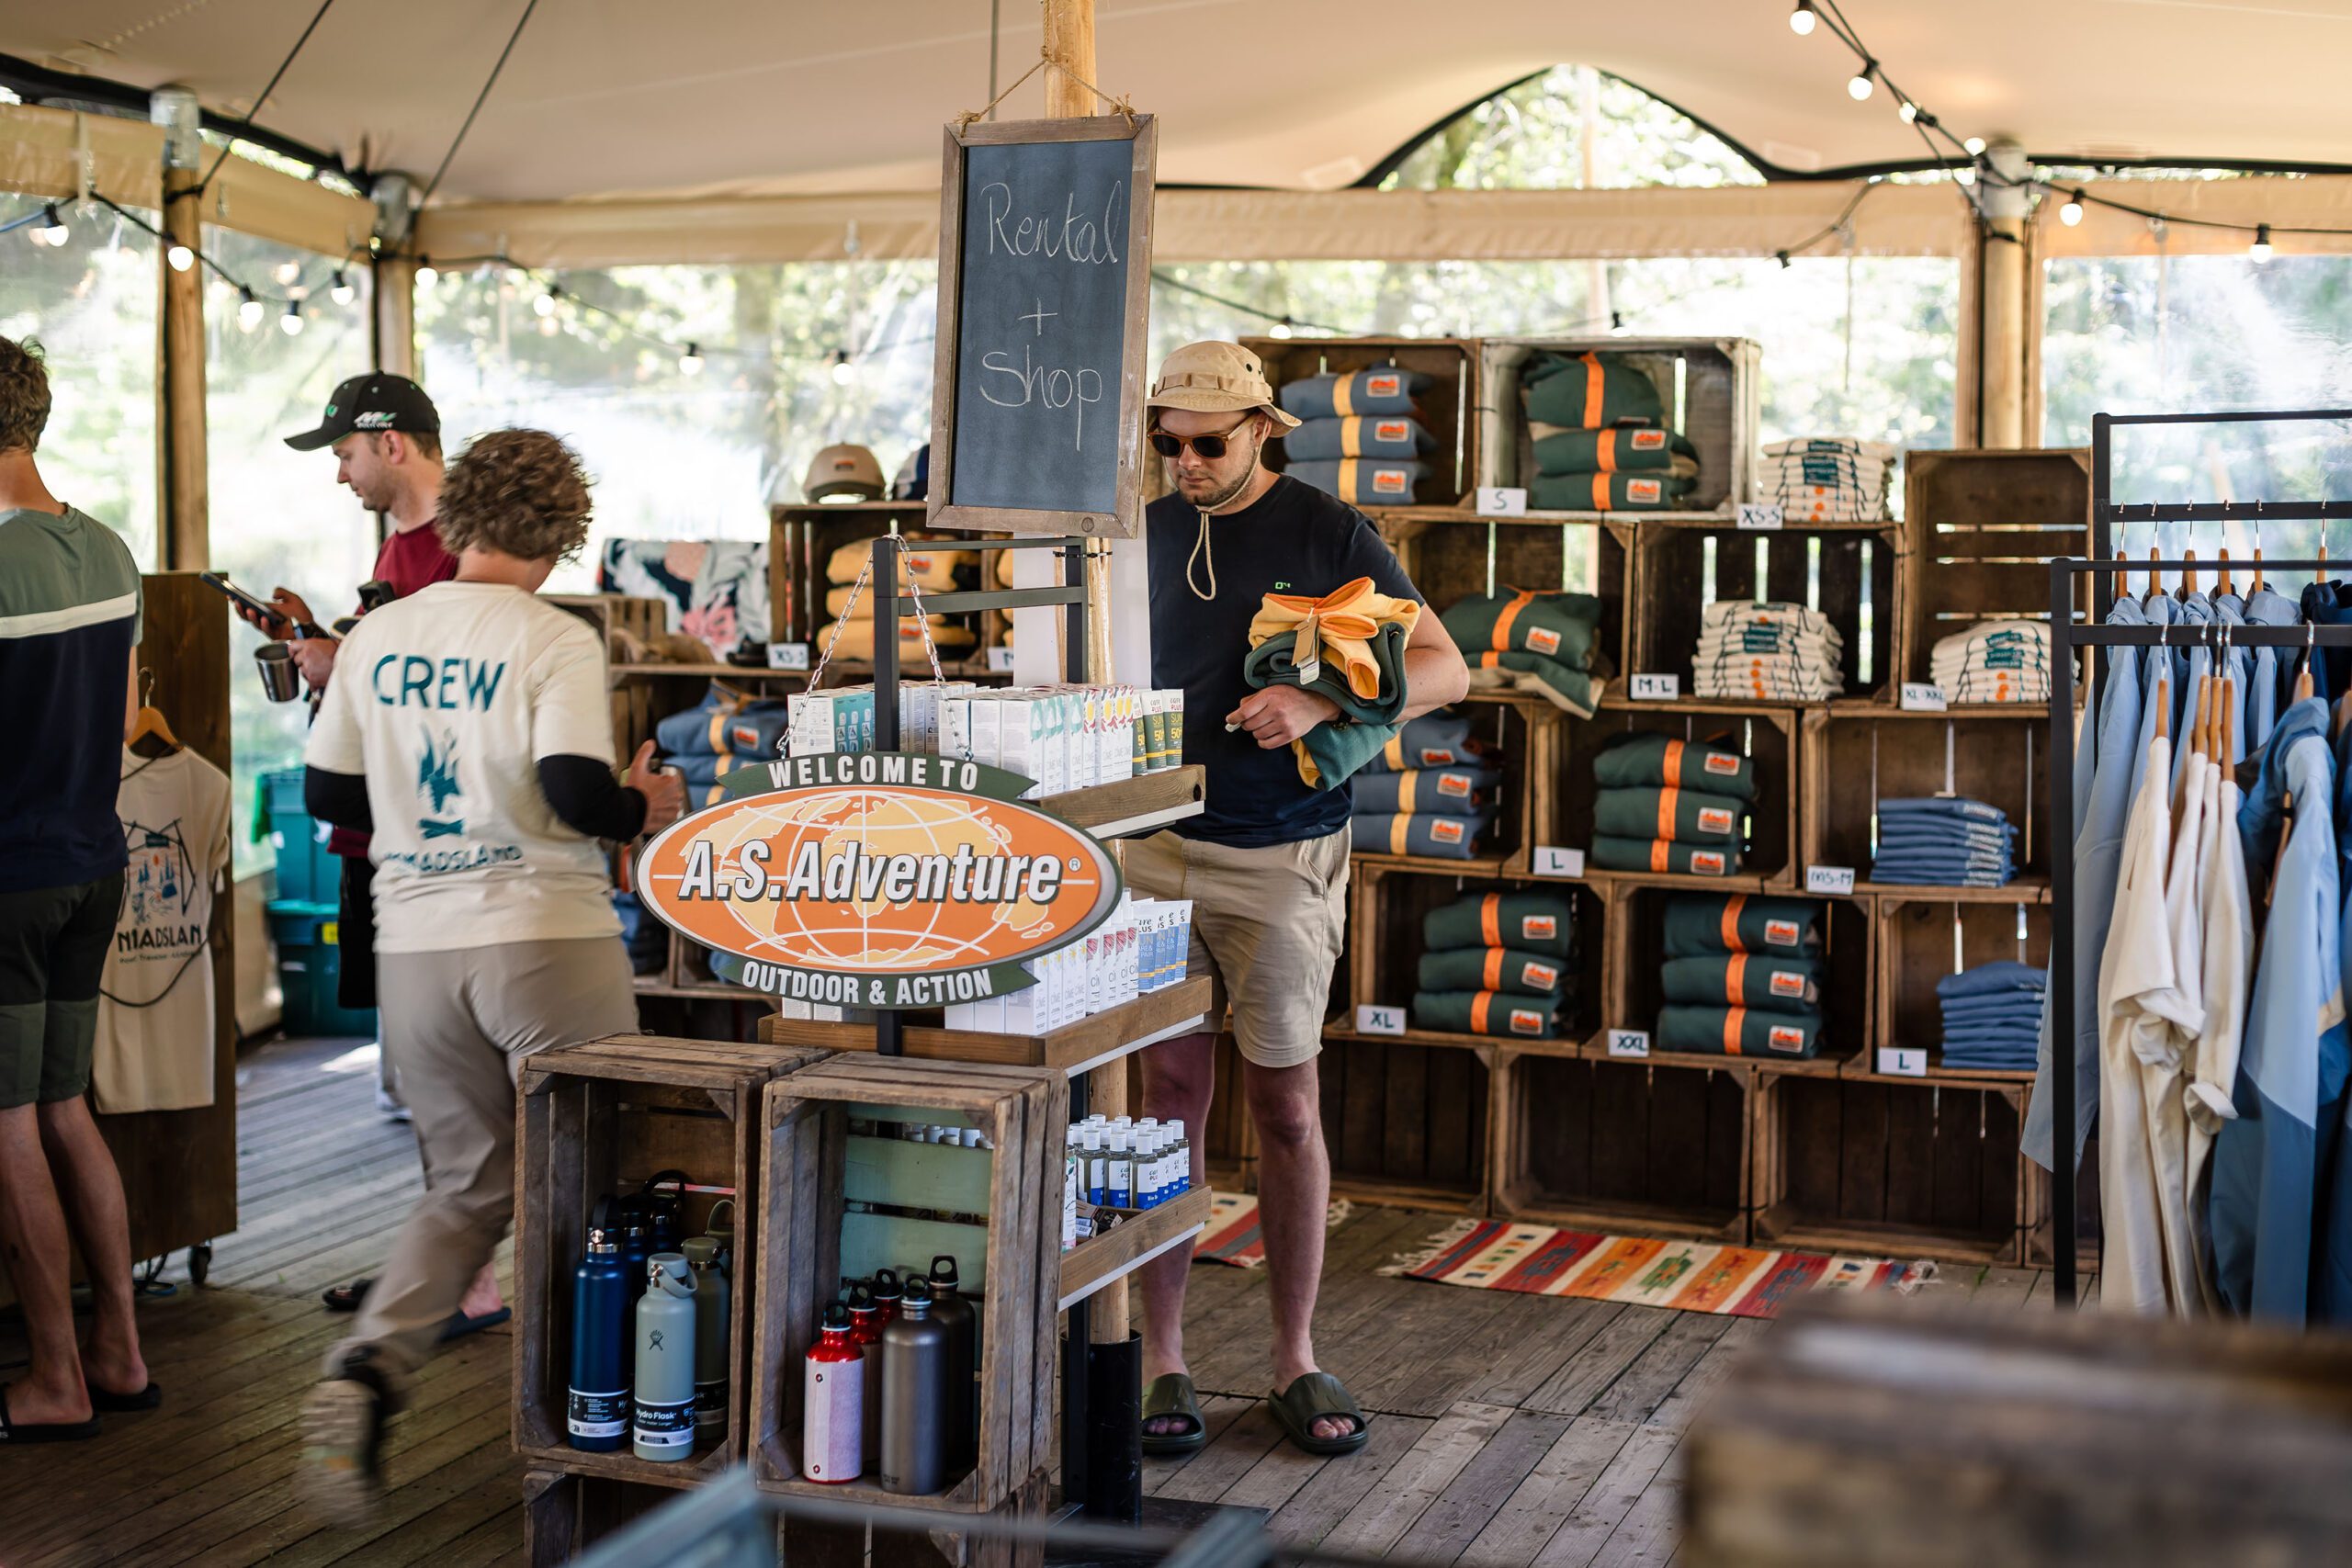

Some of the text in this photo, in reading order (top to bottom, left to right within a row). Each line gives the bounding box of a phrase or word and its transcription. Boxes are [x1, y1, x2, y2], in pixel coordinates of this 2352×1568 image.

[980, 180, 1122, 265] Rental
[1018, 297, 1058, 337] +
[978, 344, 1102, 452] Shop
[1493, 491, 1508, 510] S
[373, 653, 506, 712] CREW
[768, 754, 978, 791] WELCOME TO
[1551, 852, 1566, 870] L
[741, 961, 993, 1005] OUTDOOR & ACTION
[1371, 1010, 1394, 1029] XL
[1899, 1053, 1911, 1070] L
[636, 1408, 653, 1419] Hydro
